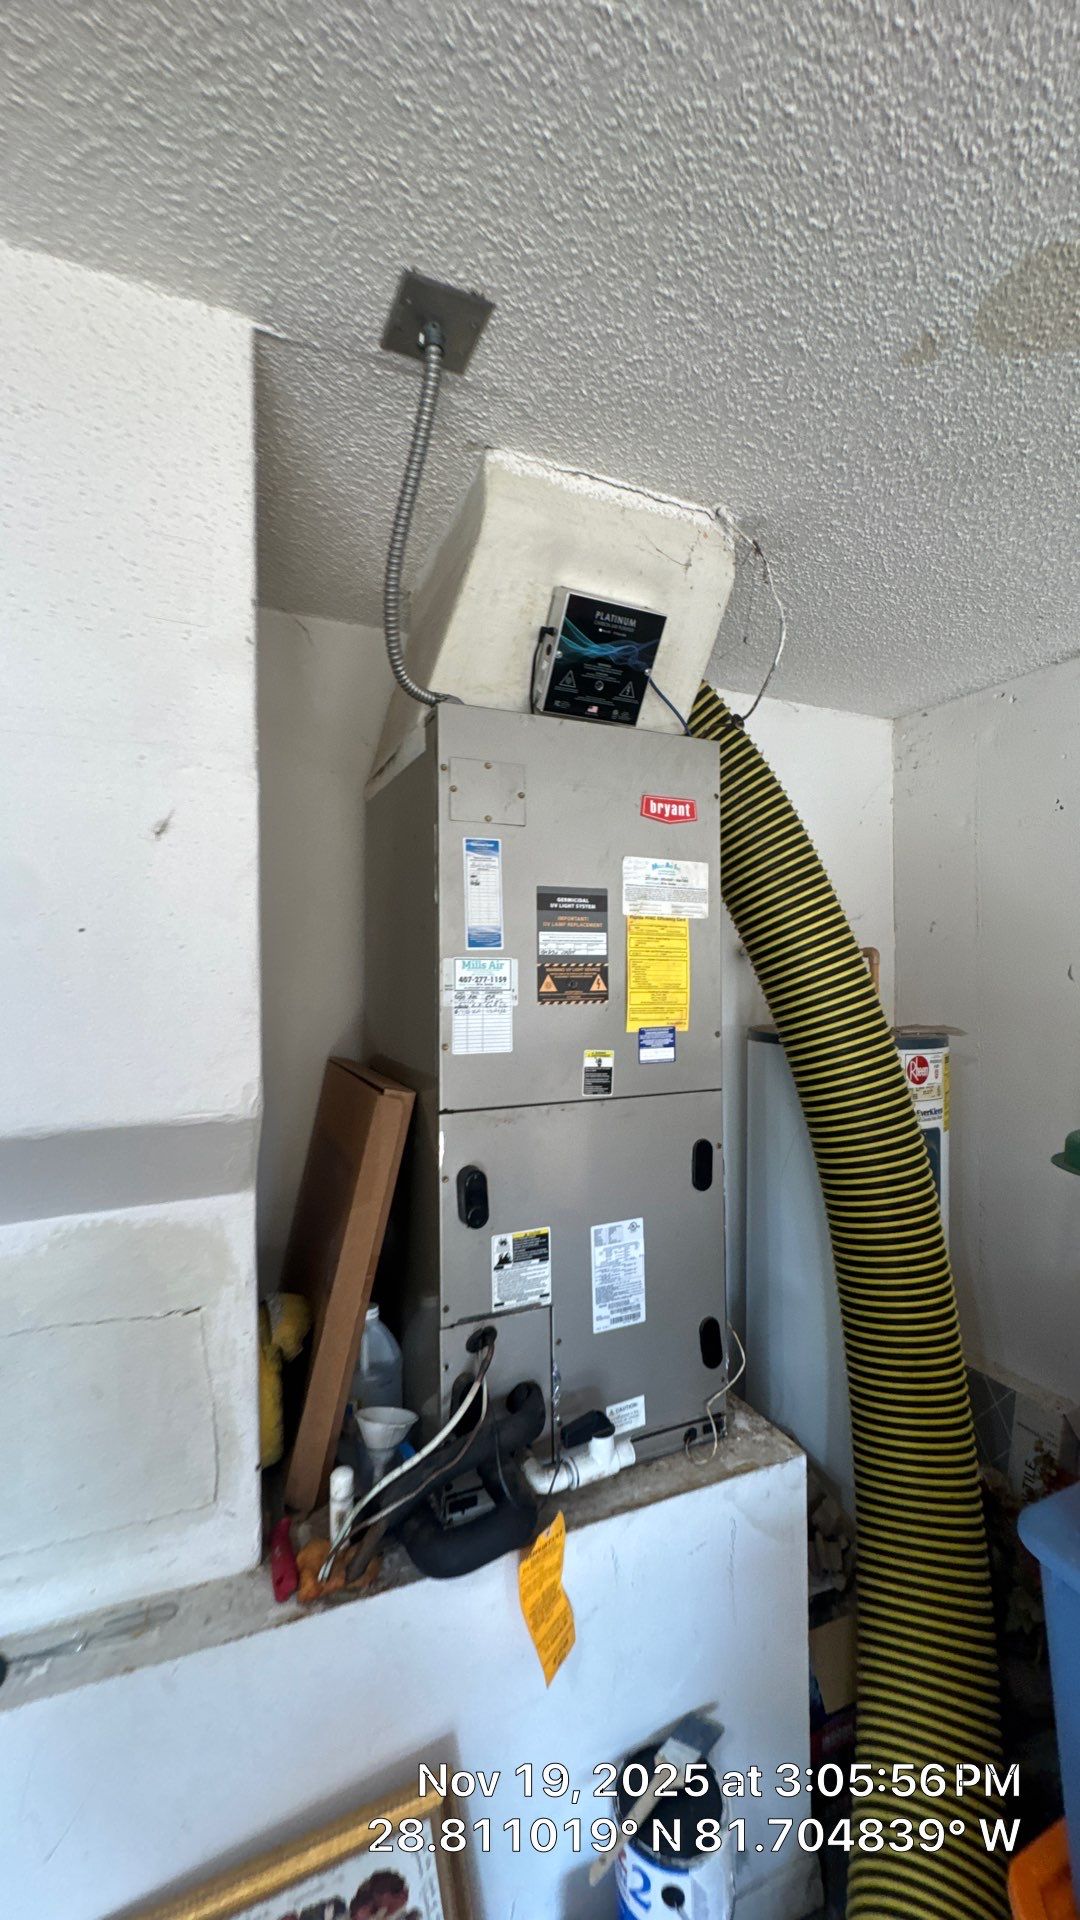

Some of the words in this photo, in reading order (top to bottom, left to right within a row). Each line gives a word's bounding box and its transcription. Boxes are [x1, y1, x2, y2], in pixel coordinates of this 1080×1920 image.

[595, 610, 637, 628] PLATINUM
[650, 799, 691, 817] bryant
[556, 896, 589, 904] GERMICIDAL
[461, 960, 488, 970] Mills
[488, 960, 505, 970] Air
[458, 976, 507, 984] 407-277-1159
[910, 1056, 929, 1082] Rheem
[615, 1402, 638, 1413] CAUTION
